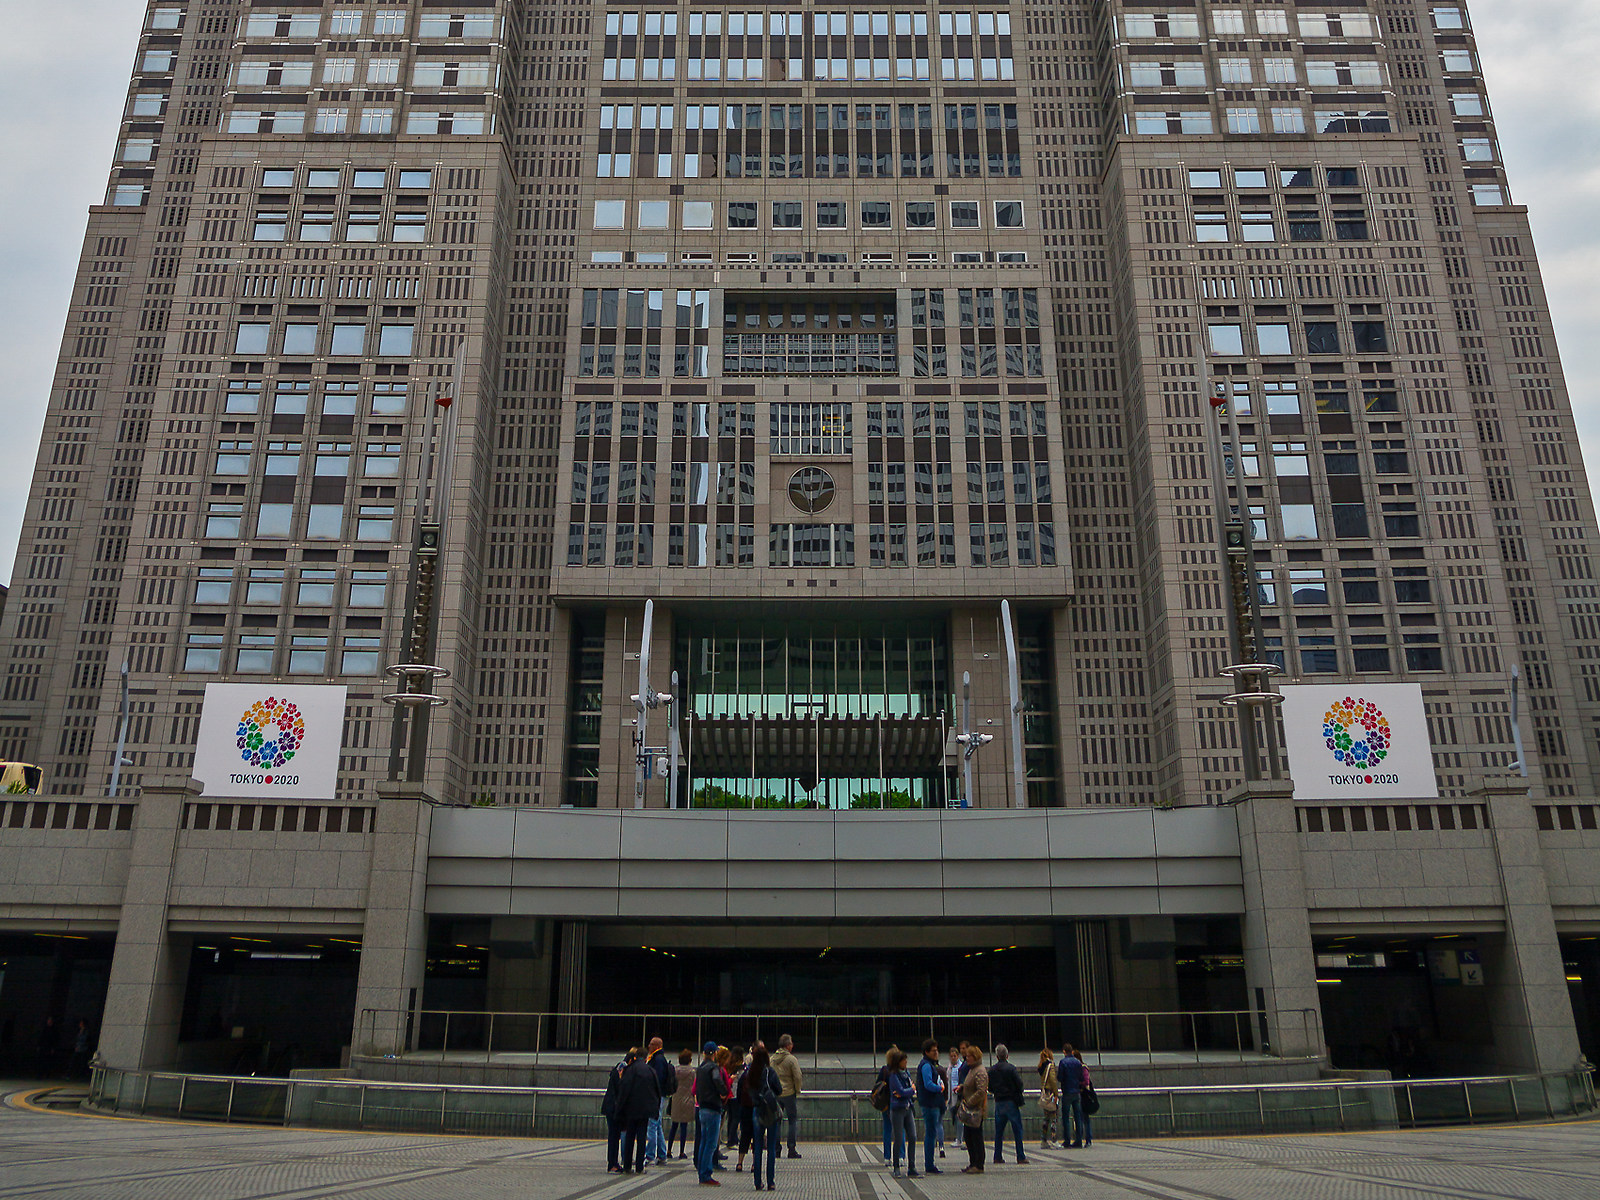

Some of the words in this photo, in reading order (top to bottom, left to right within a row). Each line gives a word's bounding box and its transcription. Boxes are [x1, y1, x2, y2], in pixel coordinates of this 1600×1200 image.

[230, 774, 264, 785] TOKYO
[274, 775, 299, 785] 2020
[1328, 774, 1363, 785] TOKYO
[1373, 774, 1399, 784] 2020
